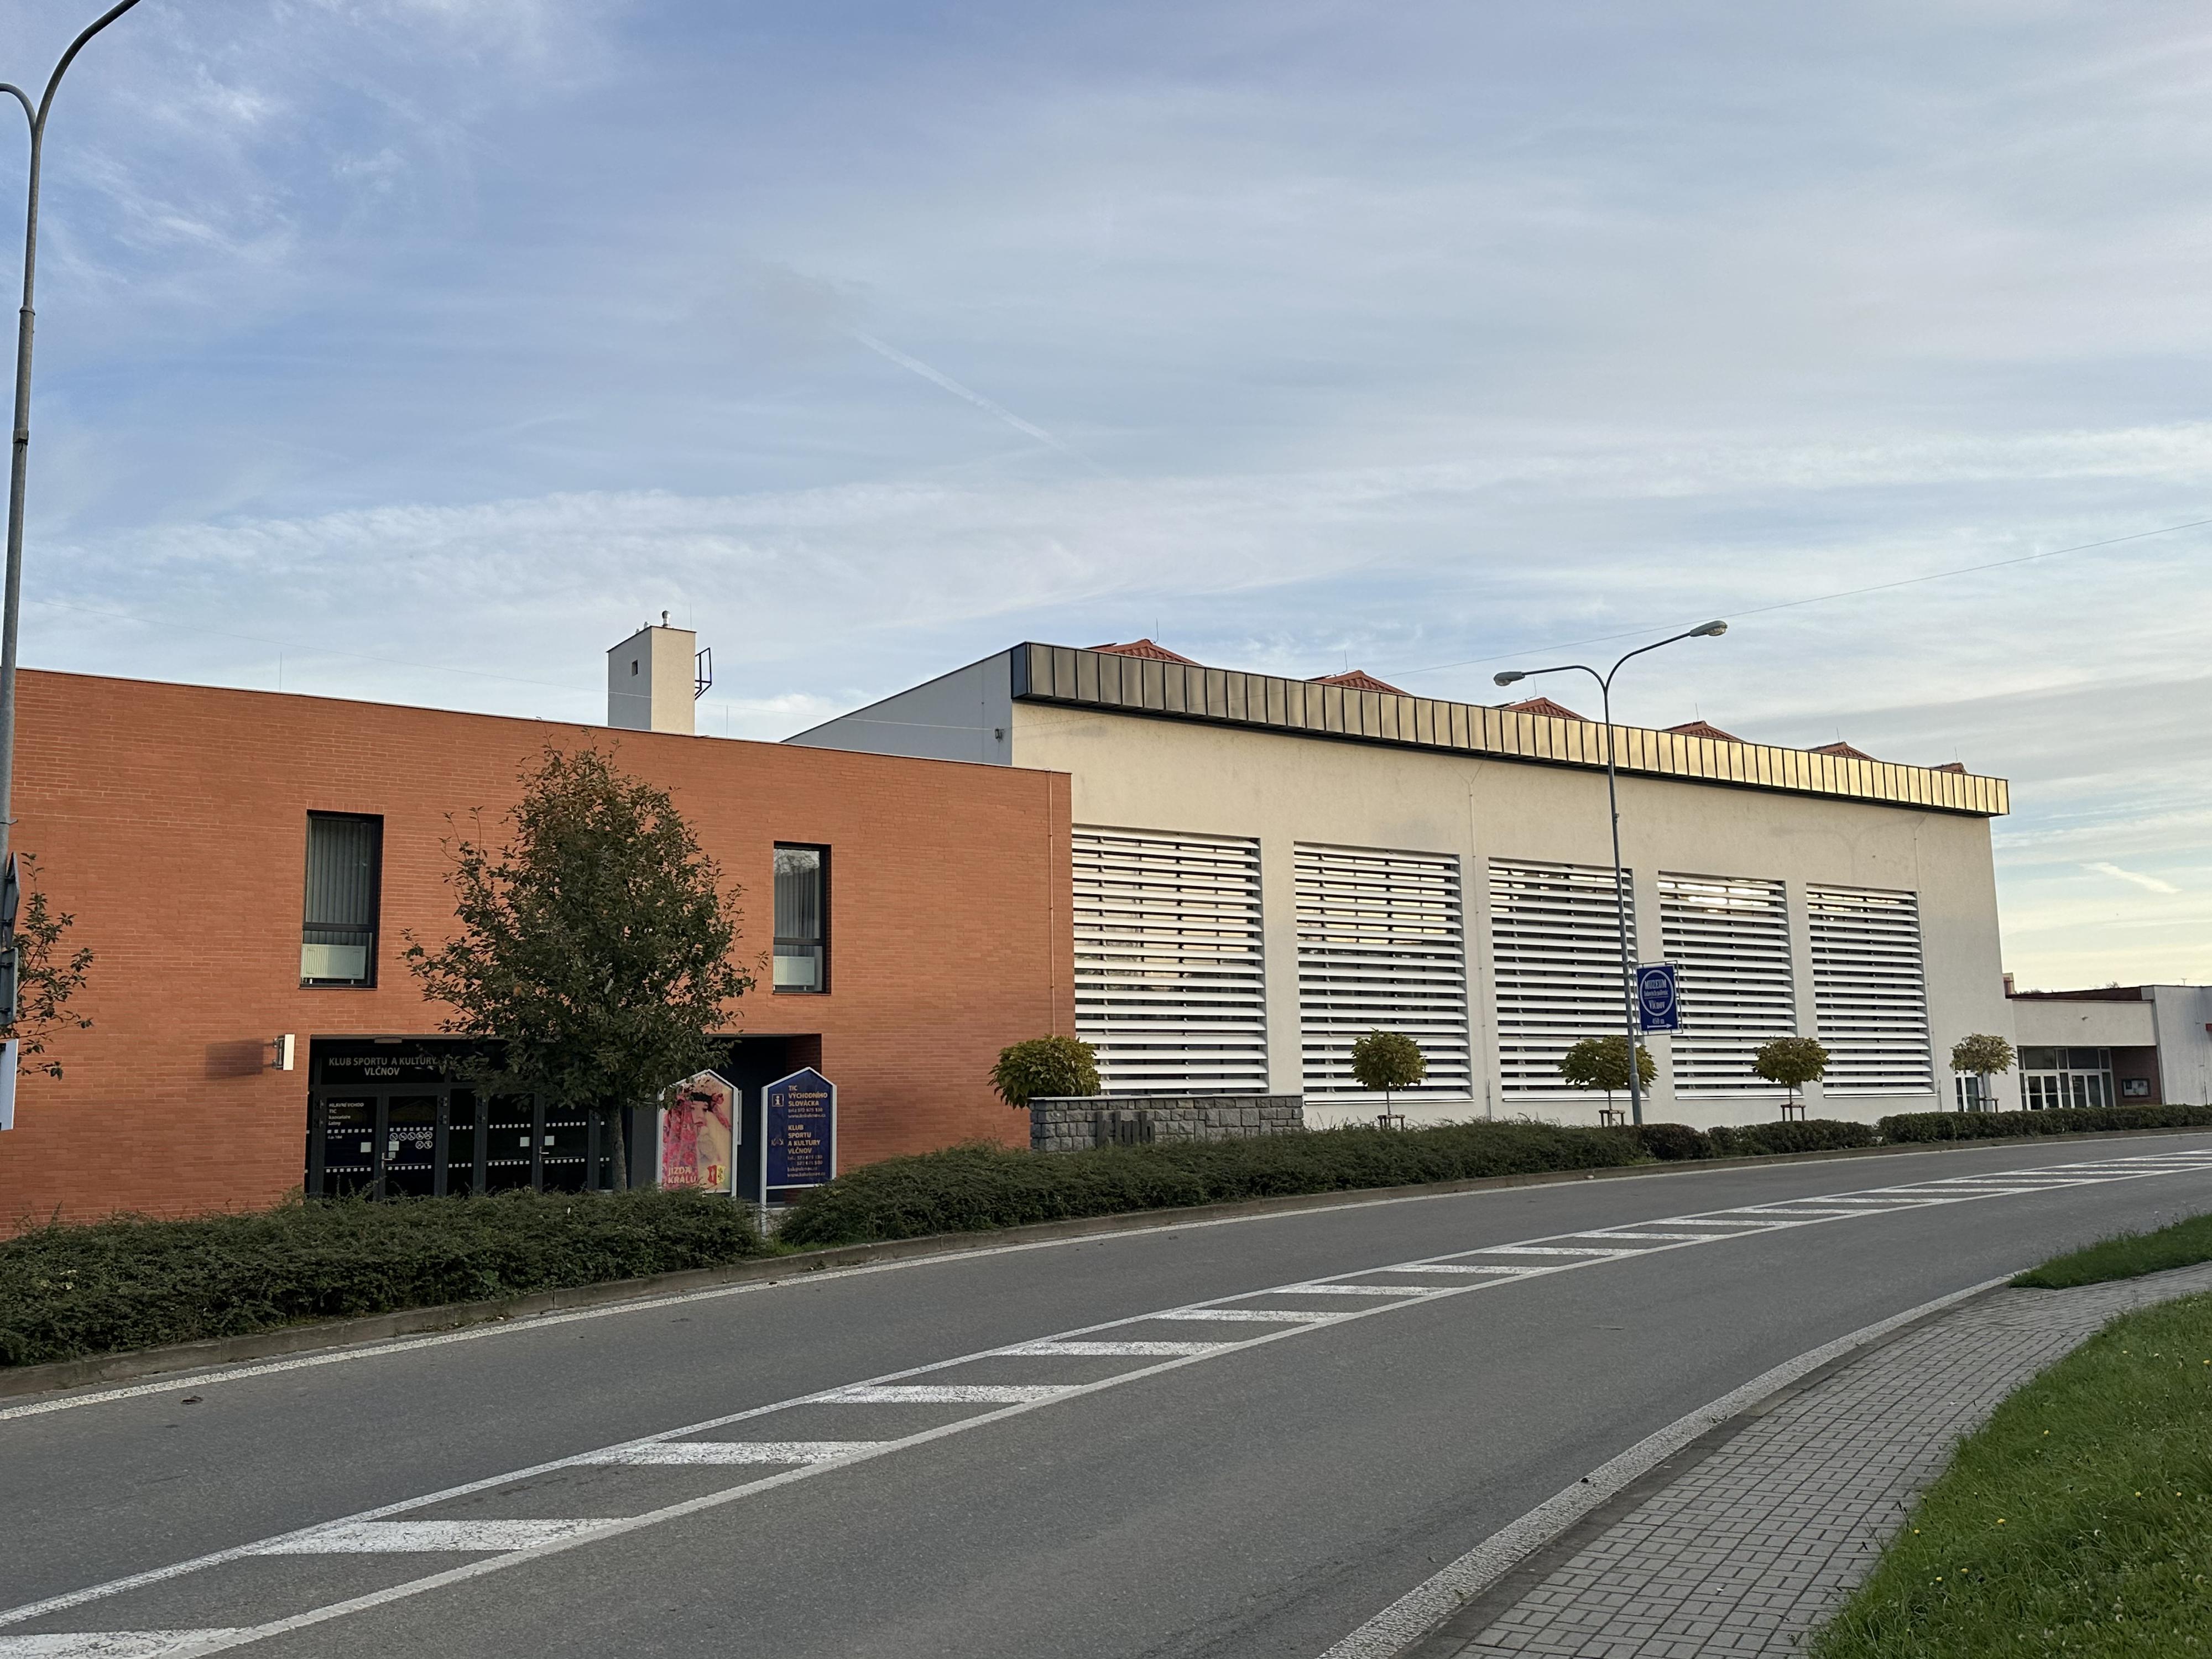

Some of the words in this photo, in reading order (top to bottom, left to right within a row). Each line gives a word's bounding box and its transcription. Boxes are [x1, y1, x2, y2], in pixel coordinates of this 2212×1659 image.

[1644, 979, 1667, 989] MUZEUM
[328, 1057, 352, 1066] KLUB
[353, 1057, 388, 1066] SPORTU
[391, 1057, 398, 1066] A
[399, 1056, 437, 1066] KULTURY
[364, 1066, 400, 1076] VLČNOV
[788, 1146, 812, 1155] VLČNOV
